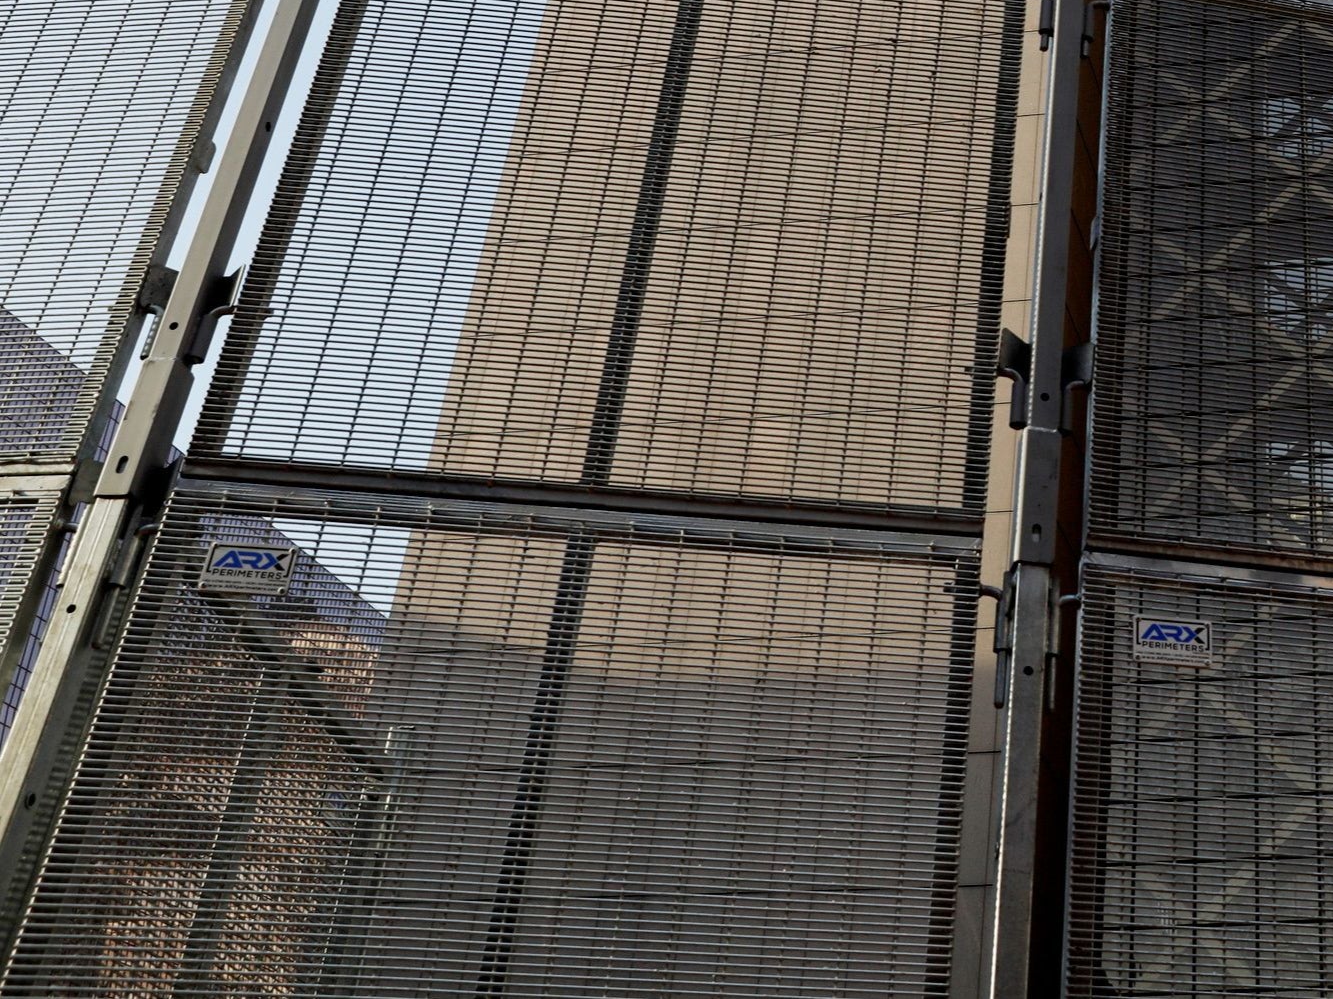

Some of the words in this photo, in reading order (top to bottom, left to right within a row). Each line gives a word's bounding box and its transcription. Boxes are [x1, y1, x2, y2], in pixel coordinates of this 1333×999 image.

[212, 550, 290, 571] ARX
[211, 568, 282, 580] PERIMETERS
[1141, 623, 1205, 644] ARX
[1142, 641, 1204, 652] PERIMETERS
